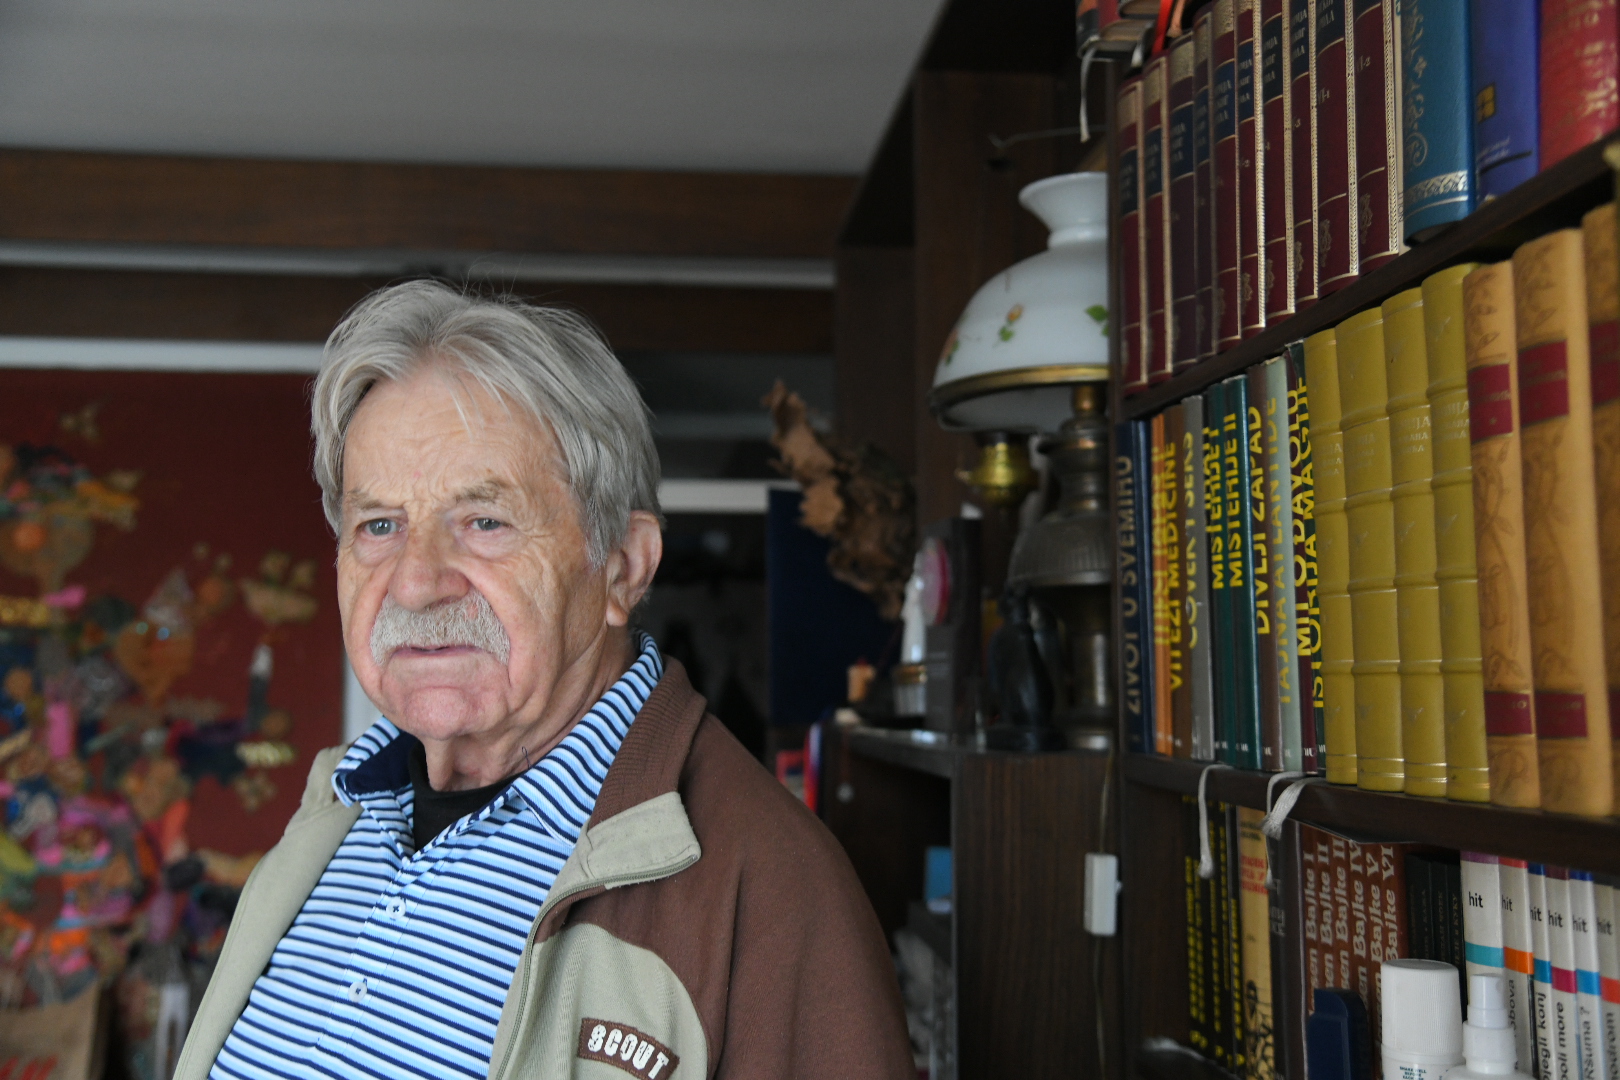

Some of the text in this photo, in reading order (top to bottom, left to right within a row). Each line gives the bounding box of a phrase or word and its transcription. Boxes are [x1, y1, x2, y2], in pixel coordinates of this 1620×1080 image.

[1223, 412, 1244, 588] MISTERIJE II
[1248, 406, 1271, 635] DIVLJI ZAPAD
[1266, 396, 1292, 704] TAJNA ATLANTIDE
[1293, 554, 1308, 588] O
[1295, 602, 1312, 657] MIT
[1304, 533, 1325, 708] ISTORIJA
[1303, 851, 1314, 863] I
[1316, 843, 1330, 865] II
[1349, 840, 1363, 874] IV
[1365, 852, 1380, 877] V
[1304, 867, 1317, 941] Bajke
[1318, 871, 1333, 946] Bajke
[1334, 866, 1349, 944] Bajke
[1352, 879, 1366, 959] Bajke
[1368, 884, 1383, 964] Bajke
[1380, 844, 1398, 961] Bajke VI
[1468, 891, 1484, 908] hit
[1501, 894, 1513, 912] hit
[1548, 909, 1563, 928] hit
[1572, 914, 1588, 933] hit
[1597, 916, 1613, 936] hit
[1535, 991, 1547, 1030] konj
[1556, 1001, 1567, 1048] more
[587, 1023, 670, 1080] SCOUT
